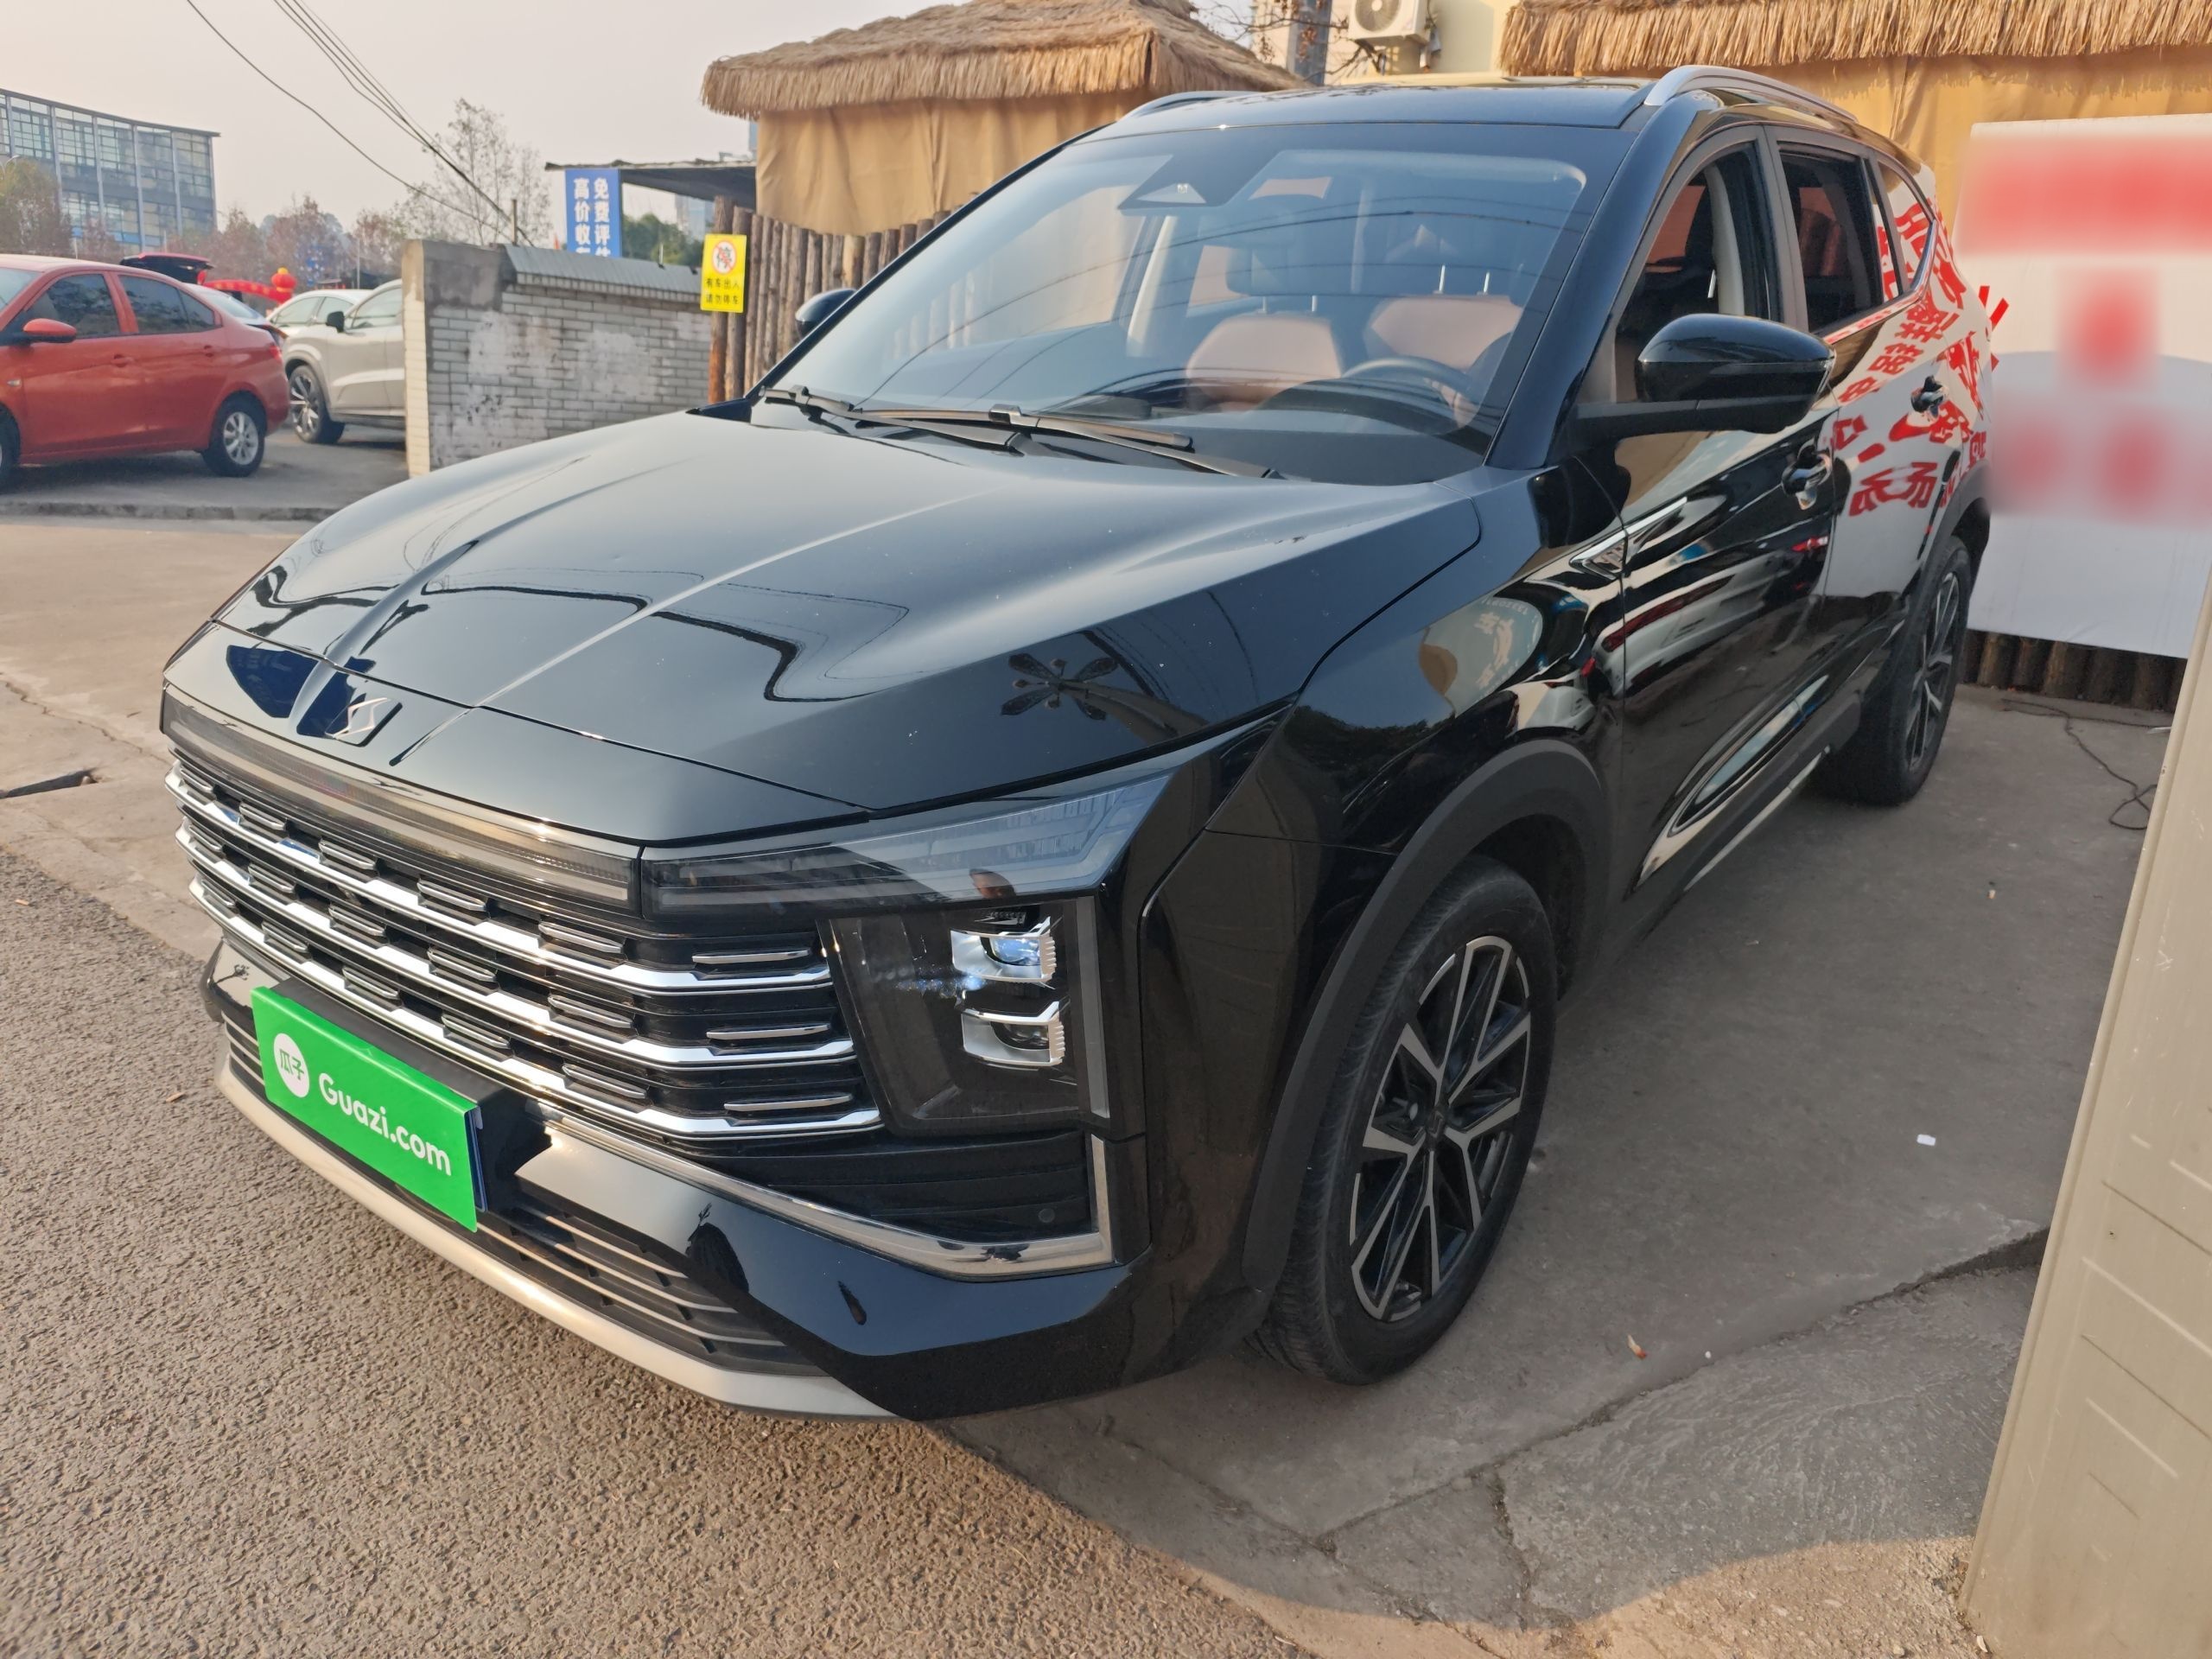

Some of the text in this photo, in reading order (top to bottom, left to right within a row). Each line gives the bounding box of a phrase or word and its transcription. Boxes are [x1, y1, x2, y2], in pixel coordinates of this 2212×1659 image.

[573, 177, 591, 254] 高价收
[278, 1048, 305, 1081] 瓜子
[319, 1072, 452, 1176] Guazi.com
